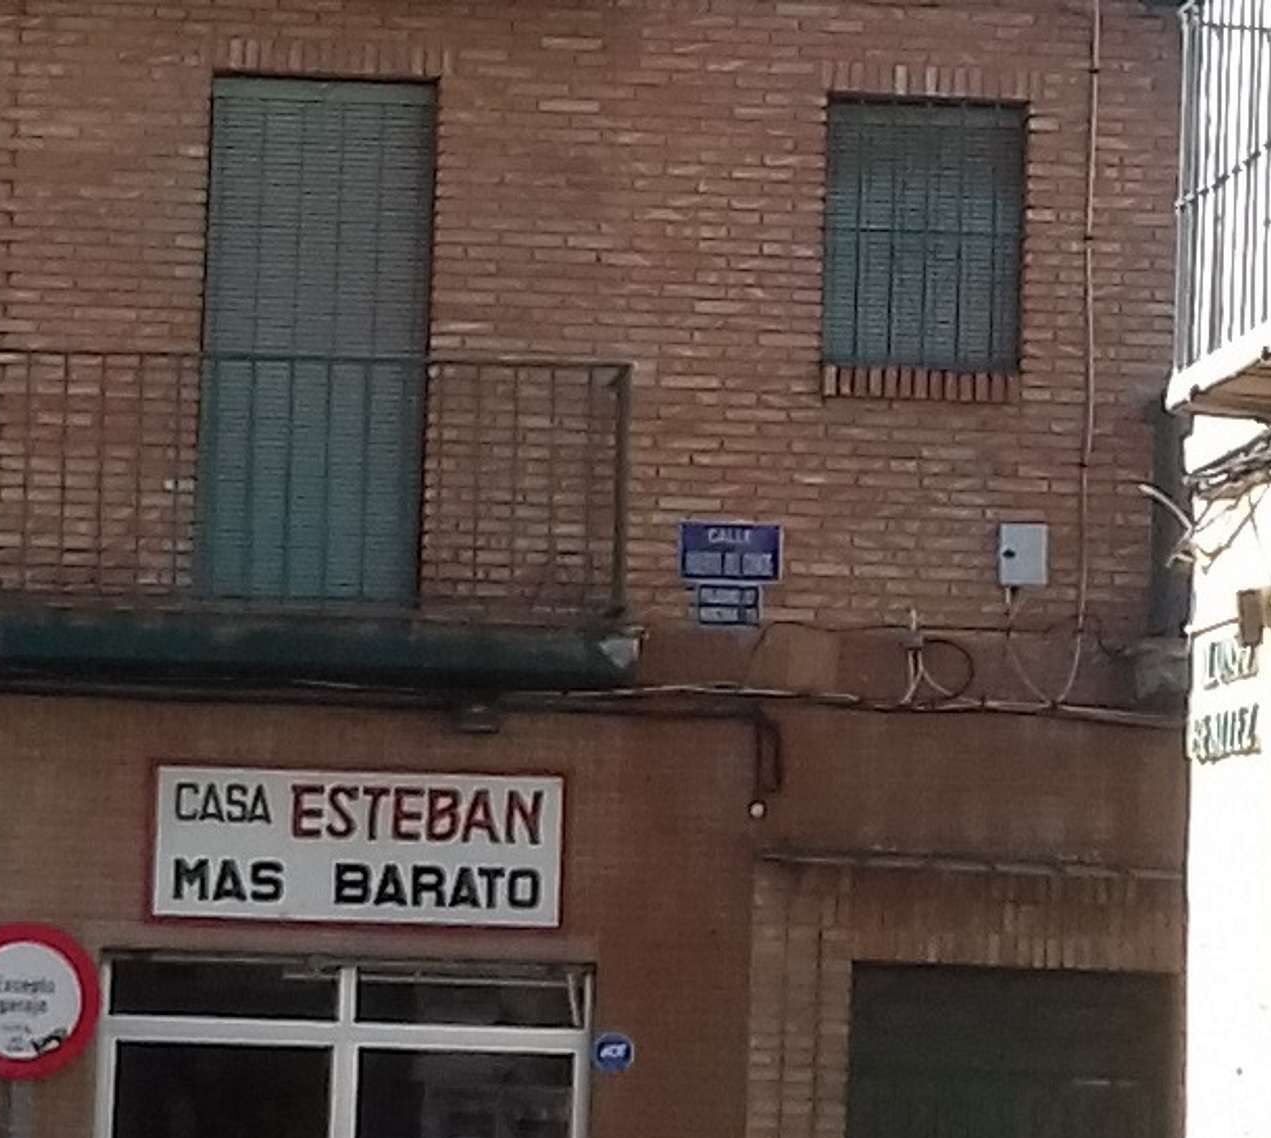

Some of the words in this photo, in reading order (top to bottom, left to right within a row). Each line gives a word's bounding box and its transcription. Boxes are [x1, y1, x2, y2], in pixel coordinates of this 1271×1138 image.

[174, 781, 272, 825] CASA
[290, 783, 545, 845] ESTEBAN
[171, 857, 285, 902] MAS
[333, 860, 541, 909] BARATO
